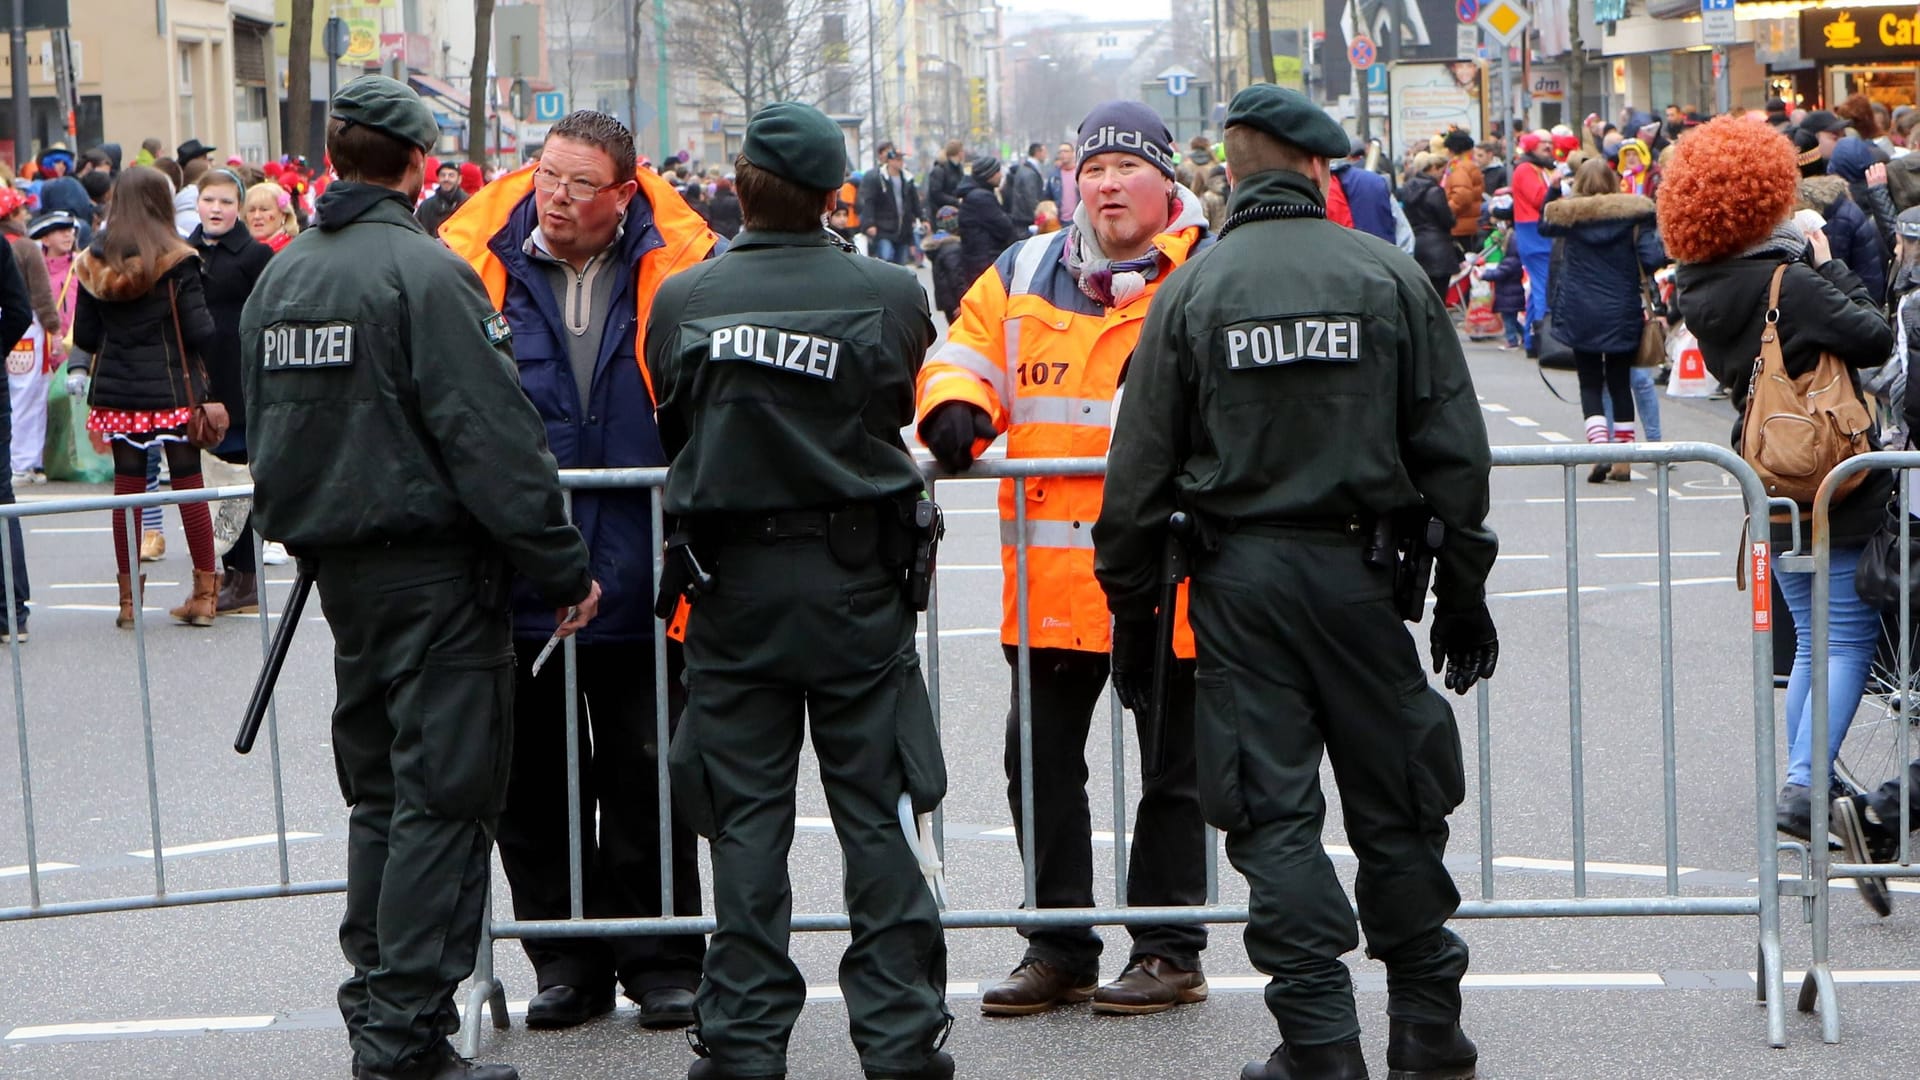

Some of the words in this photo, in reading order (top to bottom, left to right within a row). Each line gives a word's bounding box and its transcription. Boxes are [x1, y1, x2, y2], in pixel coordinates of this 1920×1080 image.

[1168, 76, 1187, 95] U
[1535, 77, 1560, 91] dm
[540, 95, 559, 118] U
[263, 325, 353, 367] POLIZEI
[711, 324, 839, 380] POLIZEI
[1227, 321, 1359, 368] POLIZEI
[1016, 361, 1070, 387] 107
[1755, 558, 1767, 581] step
